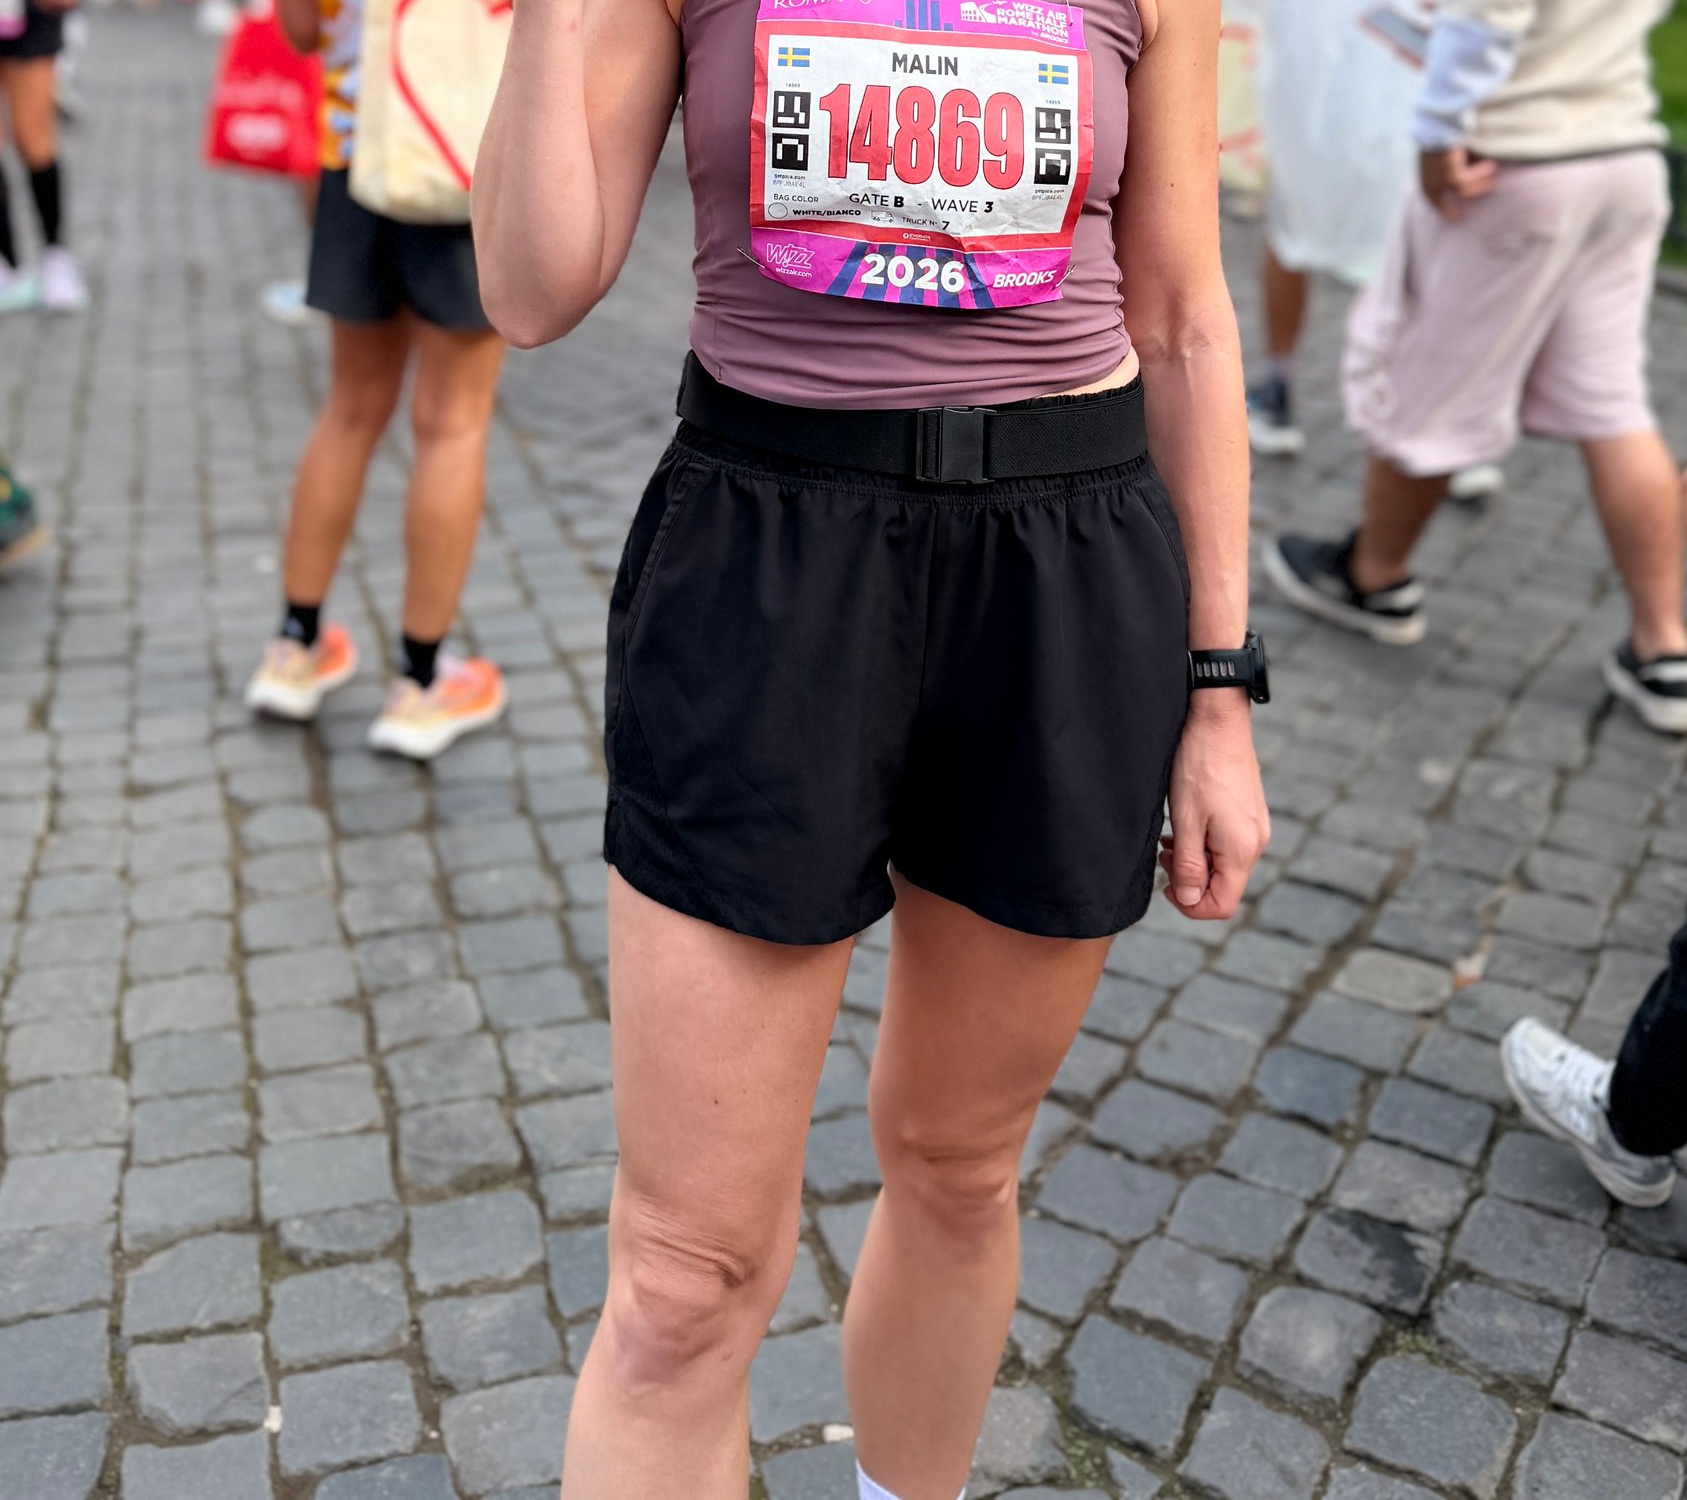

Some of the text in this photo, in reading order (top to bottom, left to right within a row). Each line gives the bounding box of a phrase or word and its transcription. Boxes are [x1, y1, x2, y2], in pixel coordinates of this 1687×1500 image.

[996, 7, 1067, 29] ROME HALF
[1012, 1, 1067, 22] WIZZ AIR
[996, 17, 1069, 39] MARATHON
[892, 52, 958, 76] MALIN
[819, 83, 1025, 190] 14869
[773, 193, 819, 203] BAG COLOR
[848, 193, 889, 207] GATE
[893, 195, 905, 208] B
[931, 197, 979, 213] WAVE
[984, 201, 994, 213] 3
[792, 209, 862, 217] WHITE/BIANCO
[902, 216, 927, 226] TRUCK
[942, 220, 951, 231] 7
[775, 267, 813, 278] wizzair.com
[861, 253, 965, 293] 2026
[993, 269, 1057, 288] BROOKS
